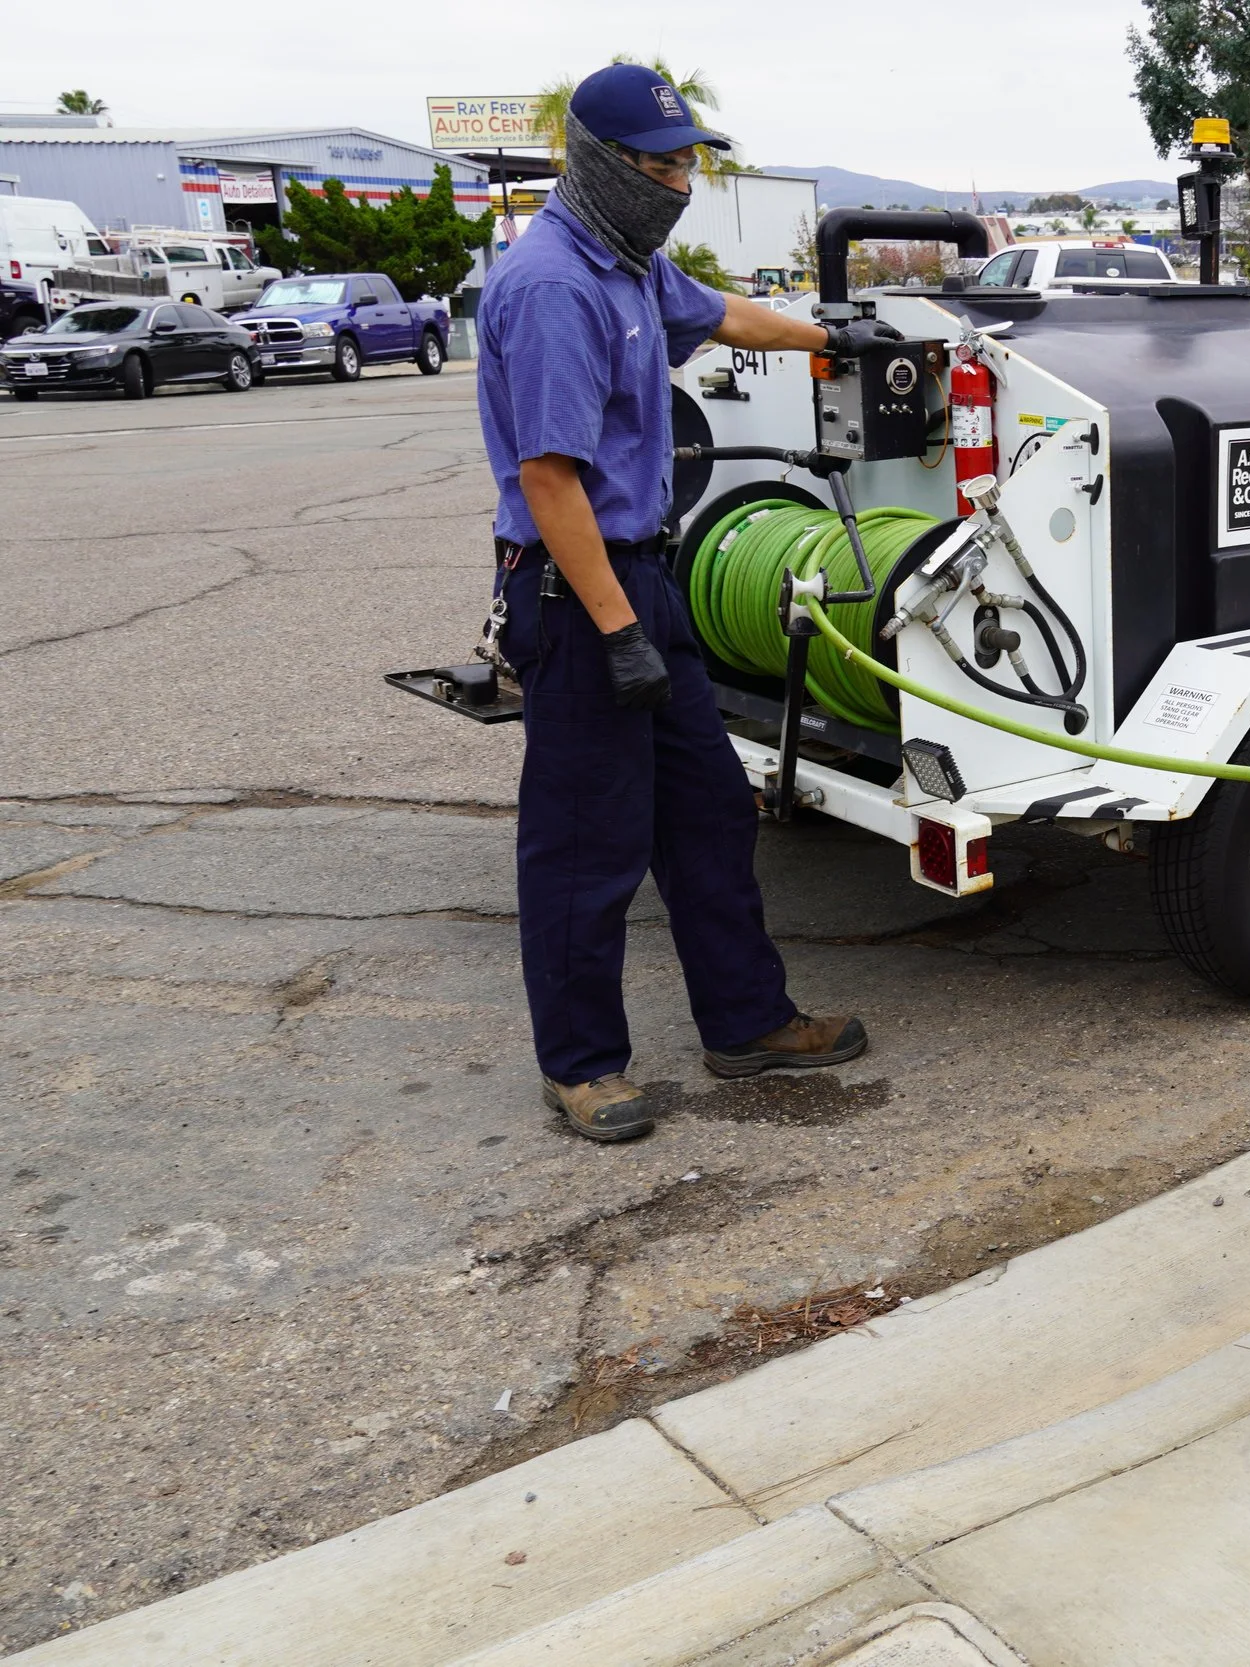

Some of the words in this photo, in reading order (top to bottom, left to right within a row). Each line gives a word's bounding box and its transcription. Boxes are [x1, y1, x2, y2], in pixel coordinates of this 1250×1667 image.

[458, 102, 486, 115] RAY
[490, 101, 526, 114] FREY
[435, 117, 484, 134] AUTO
[224, 184, 240, 198] Auto
[242, 184, 273, 200] Detailing
[1234, 510, 1250, 518] SINCE
[1170, 687, 1212, 702] WARNING
[1160, 705, 1180, 714] STAND
[1176, 702, 1204, 712] PERSONS
[1162, 712, 1180, 720] WHILE
[800, 716, 826, 729] EELCRAFT
[1156, 718, 1189, 728] OPERATION
